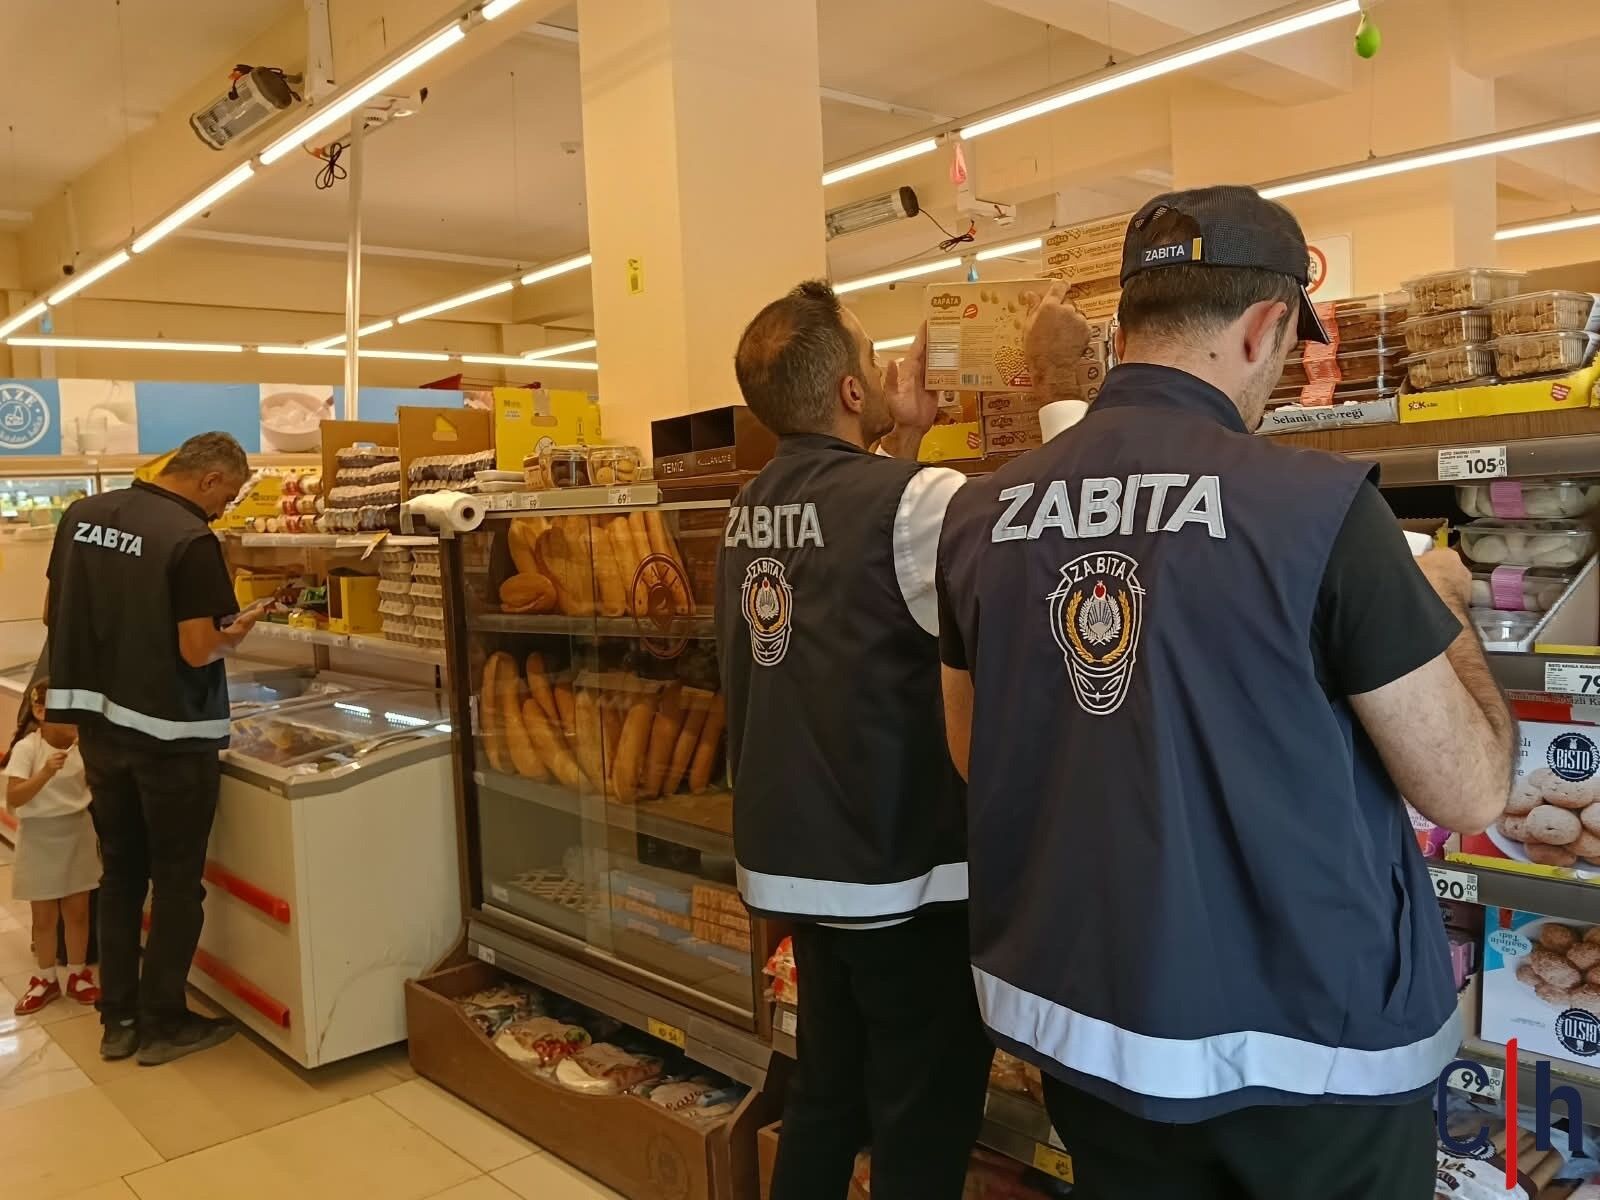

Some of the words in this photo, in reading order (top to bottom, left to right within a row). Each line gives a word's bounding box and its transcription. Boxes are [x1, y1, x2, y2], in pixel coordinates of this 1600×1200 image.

[1145, 244, 1185, 262] ZABITA
[0, 389, 38, 408] AZE
[992, 473, 1227, 544] ZABITA
[725, 503, 825, 549] ZABITA
[750, 561, 779, 579] ZABITA
[1069, 556, 1127, 583] ZABITA
